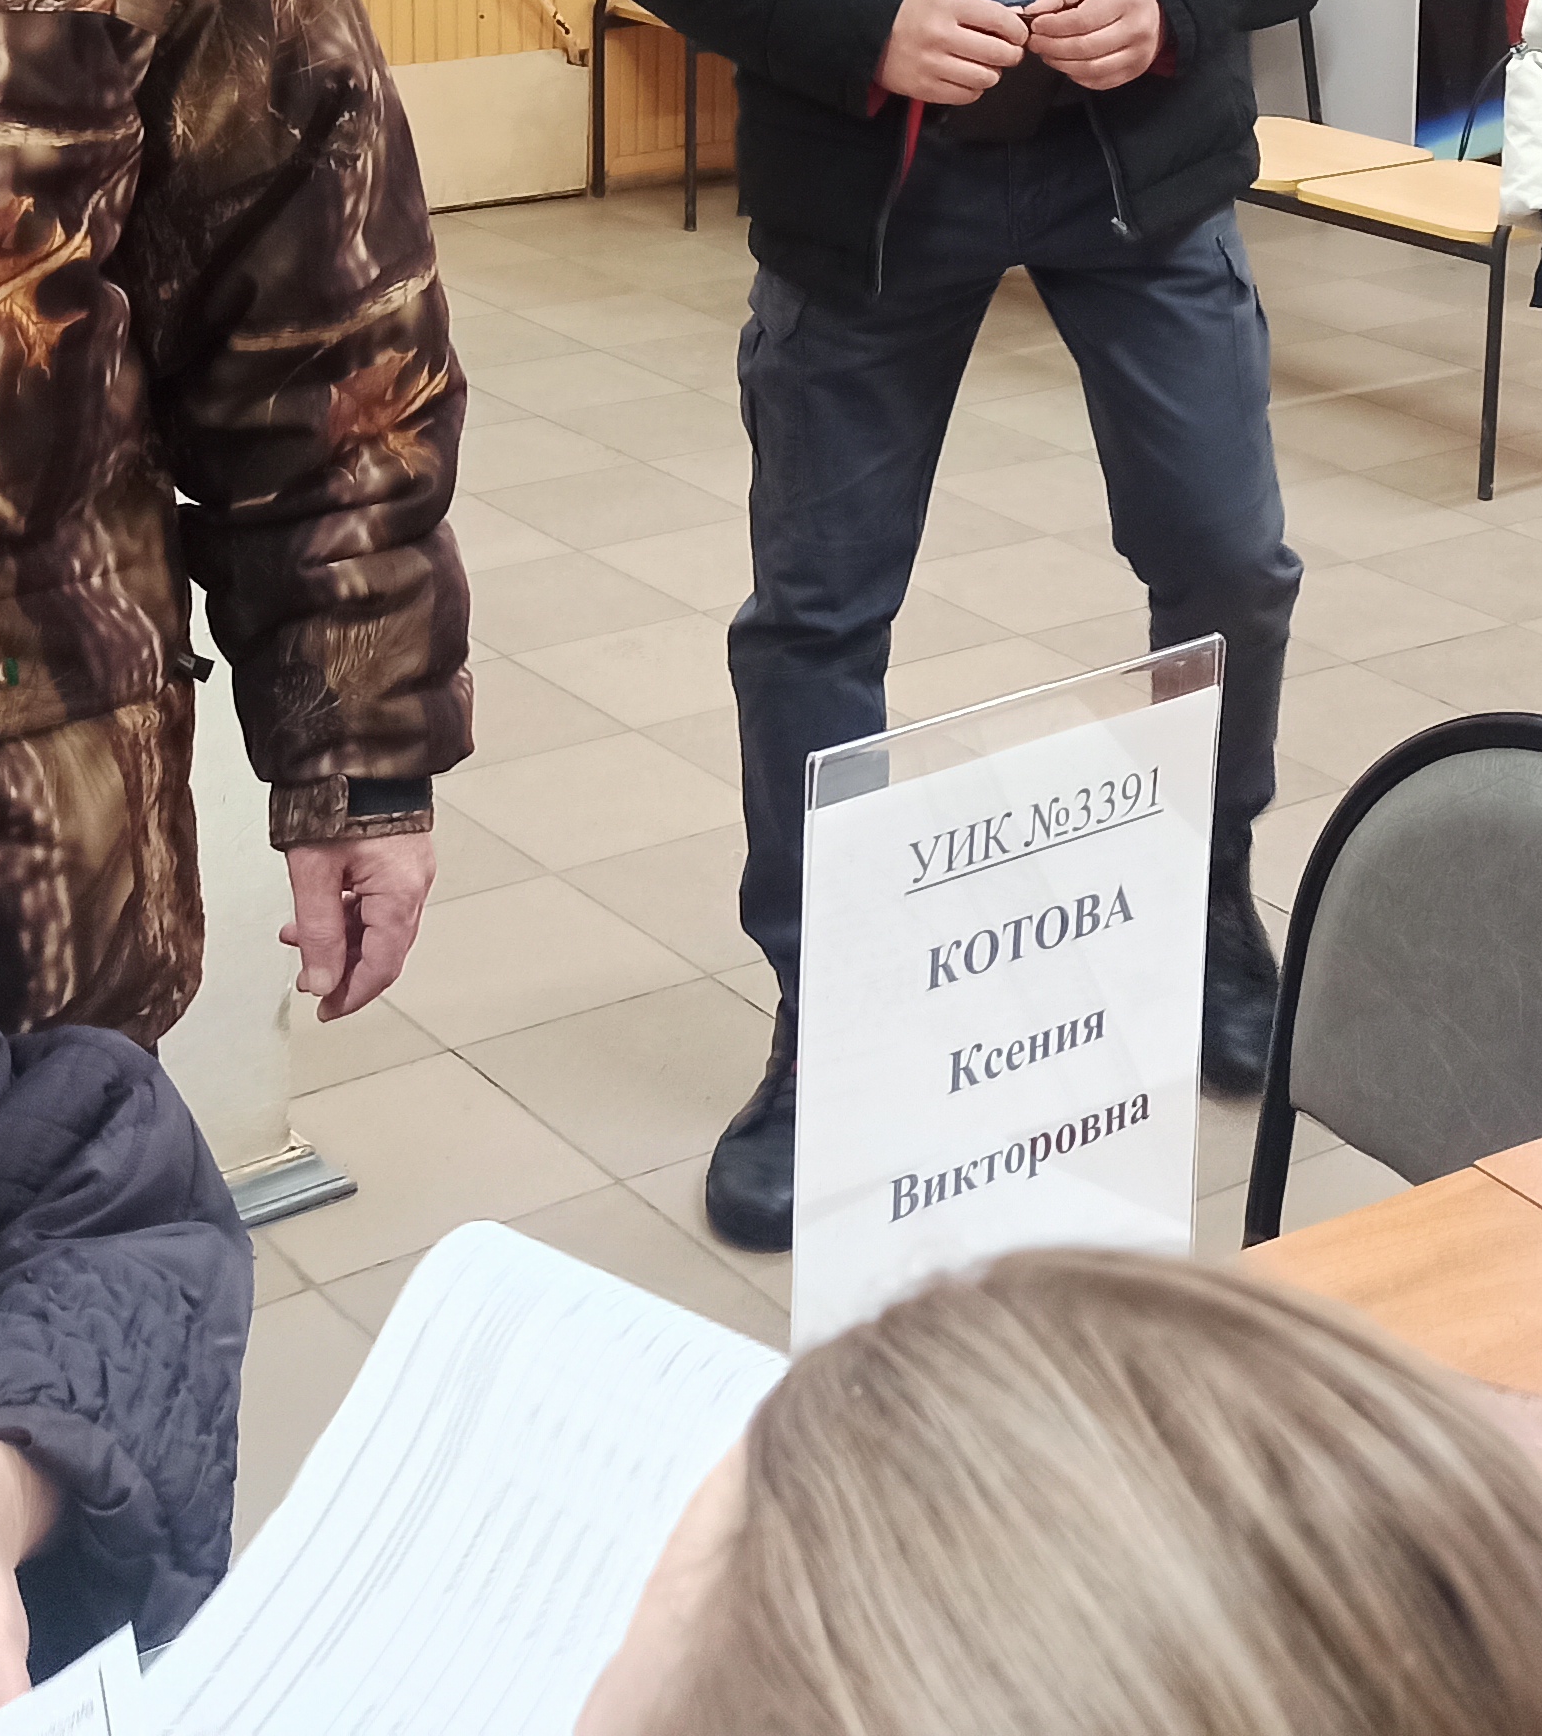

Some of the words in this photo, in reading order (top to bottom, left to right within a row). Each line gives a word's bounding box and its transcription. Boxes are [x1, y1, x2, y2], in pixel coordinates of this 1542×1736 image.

[907, 811, 1014, 884] УИК
[1022, 766, 1164, 849] №3391
[925, 883, 1135, 992] КОТОВА
[947, 1007, 1108, 1094] Ксения
[887, 1090, 1152, 1224] Викторовна
